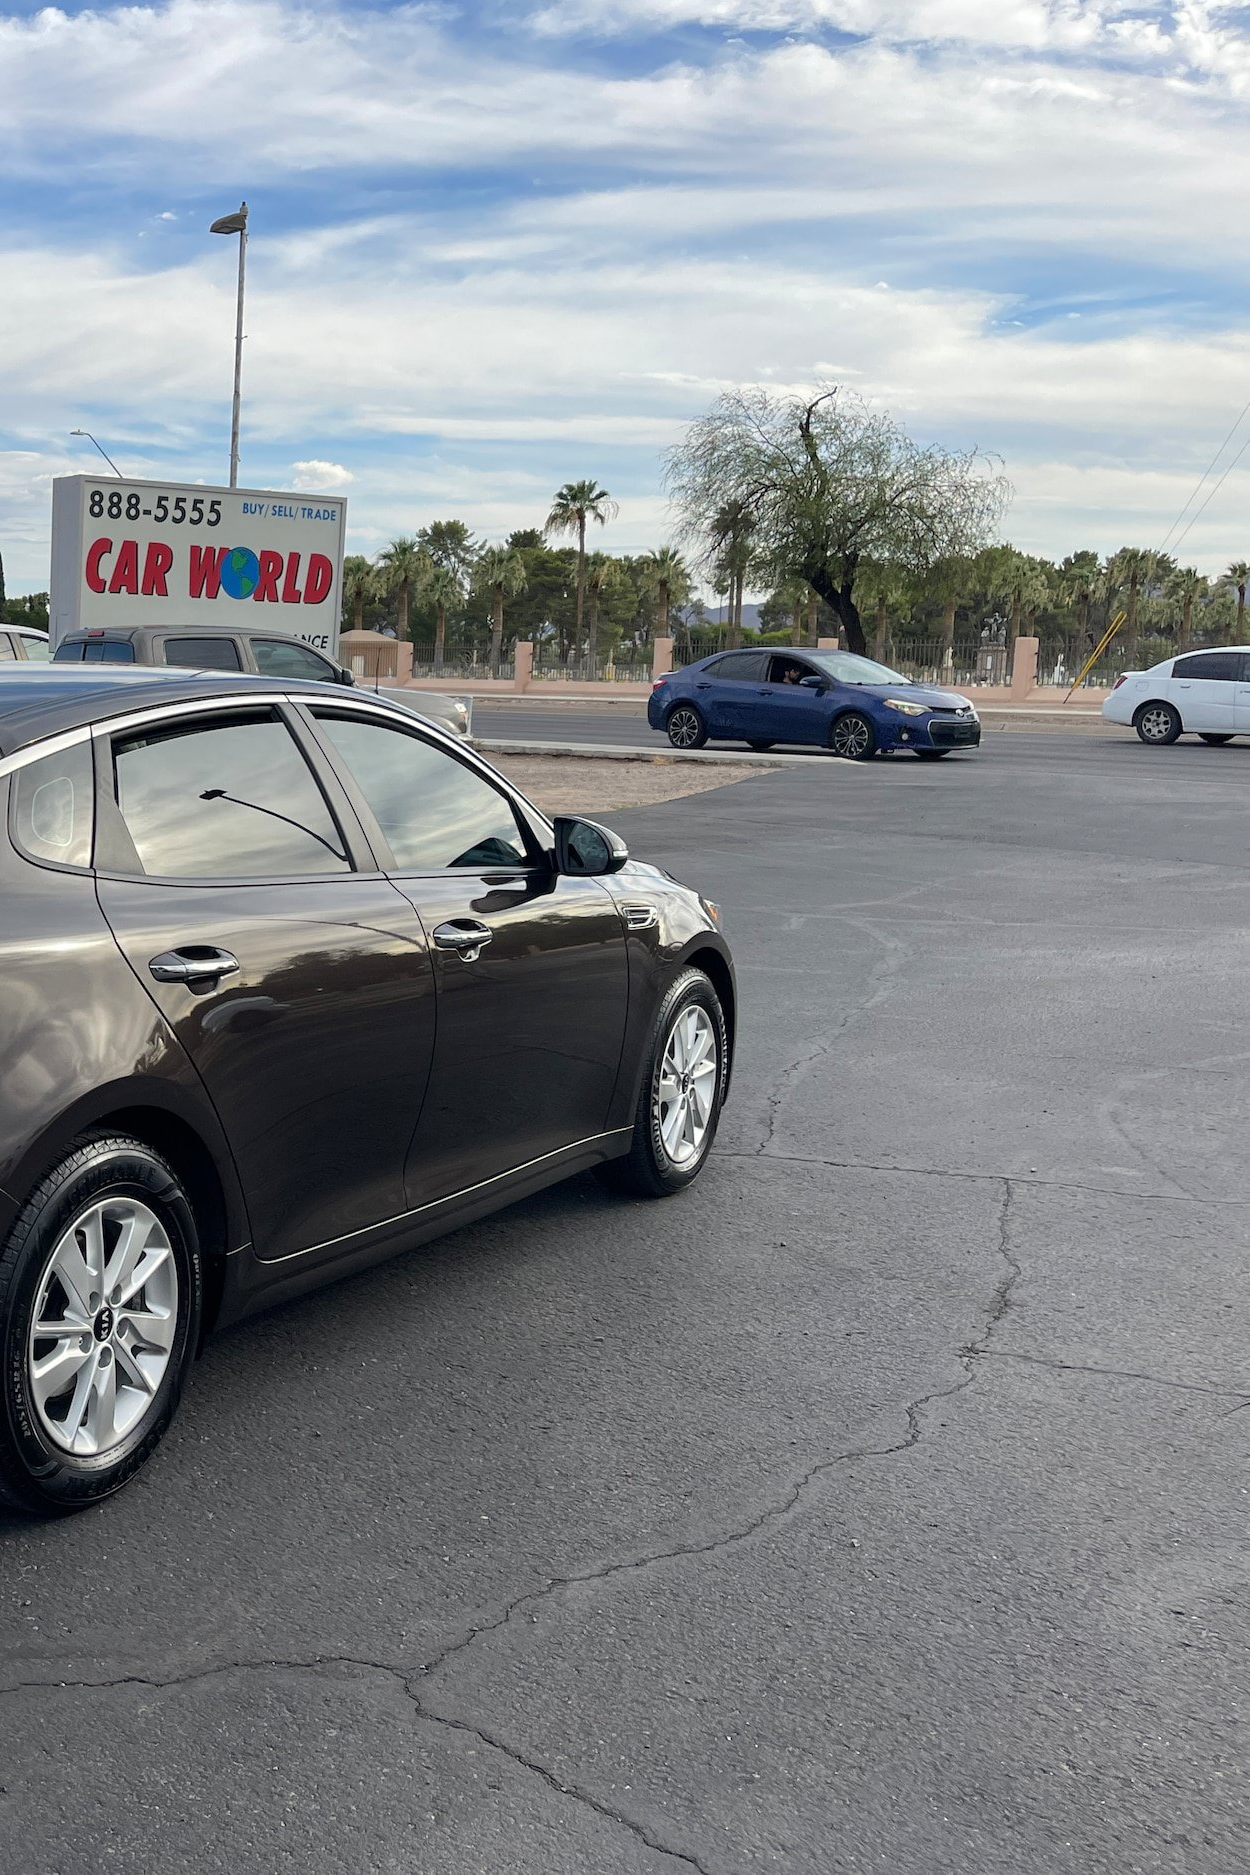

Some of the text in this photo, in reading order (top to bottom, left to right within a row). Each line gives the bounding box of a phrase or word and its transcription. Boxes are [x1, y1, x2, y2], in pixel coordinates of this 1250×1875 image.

[89, 490, 222, 526] 888-5555
[301, 507, 336, 521] TRADE
[85, 537, 333, 604] CAR WORLD
[100, 1310, 109, 1339] KIA
